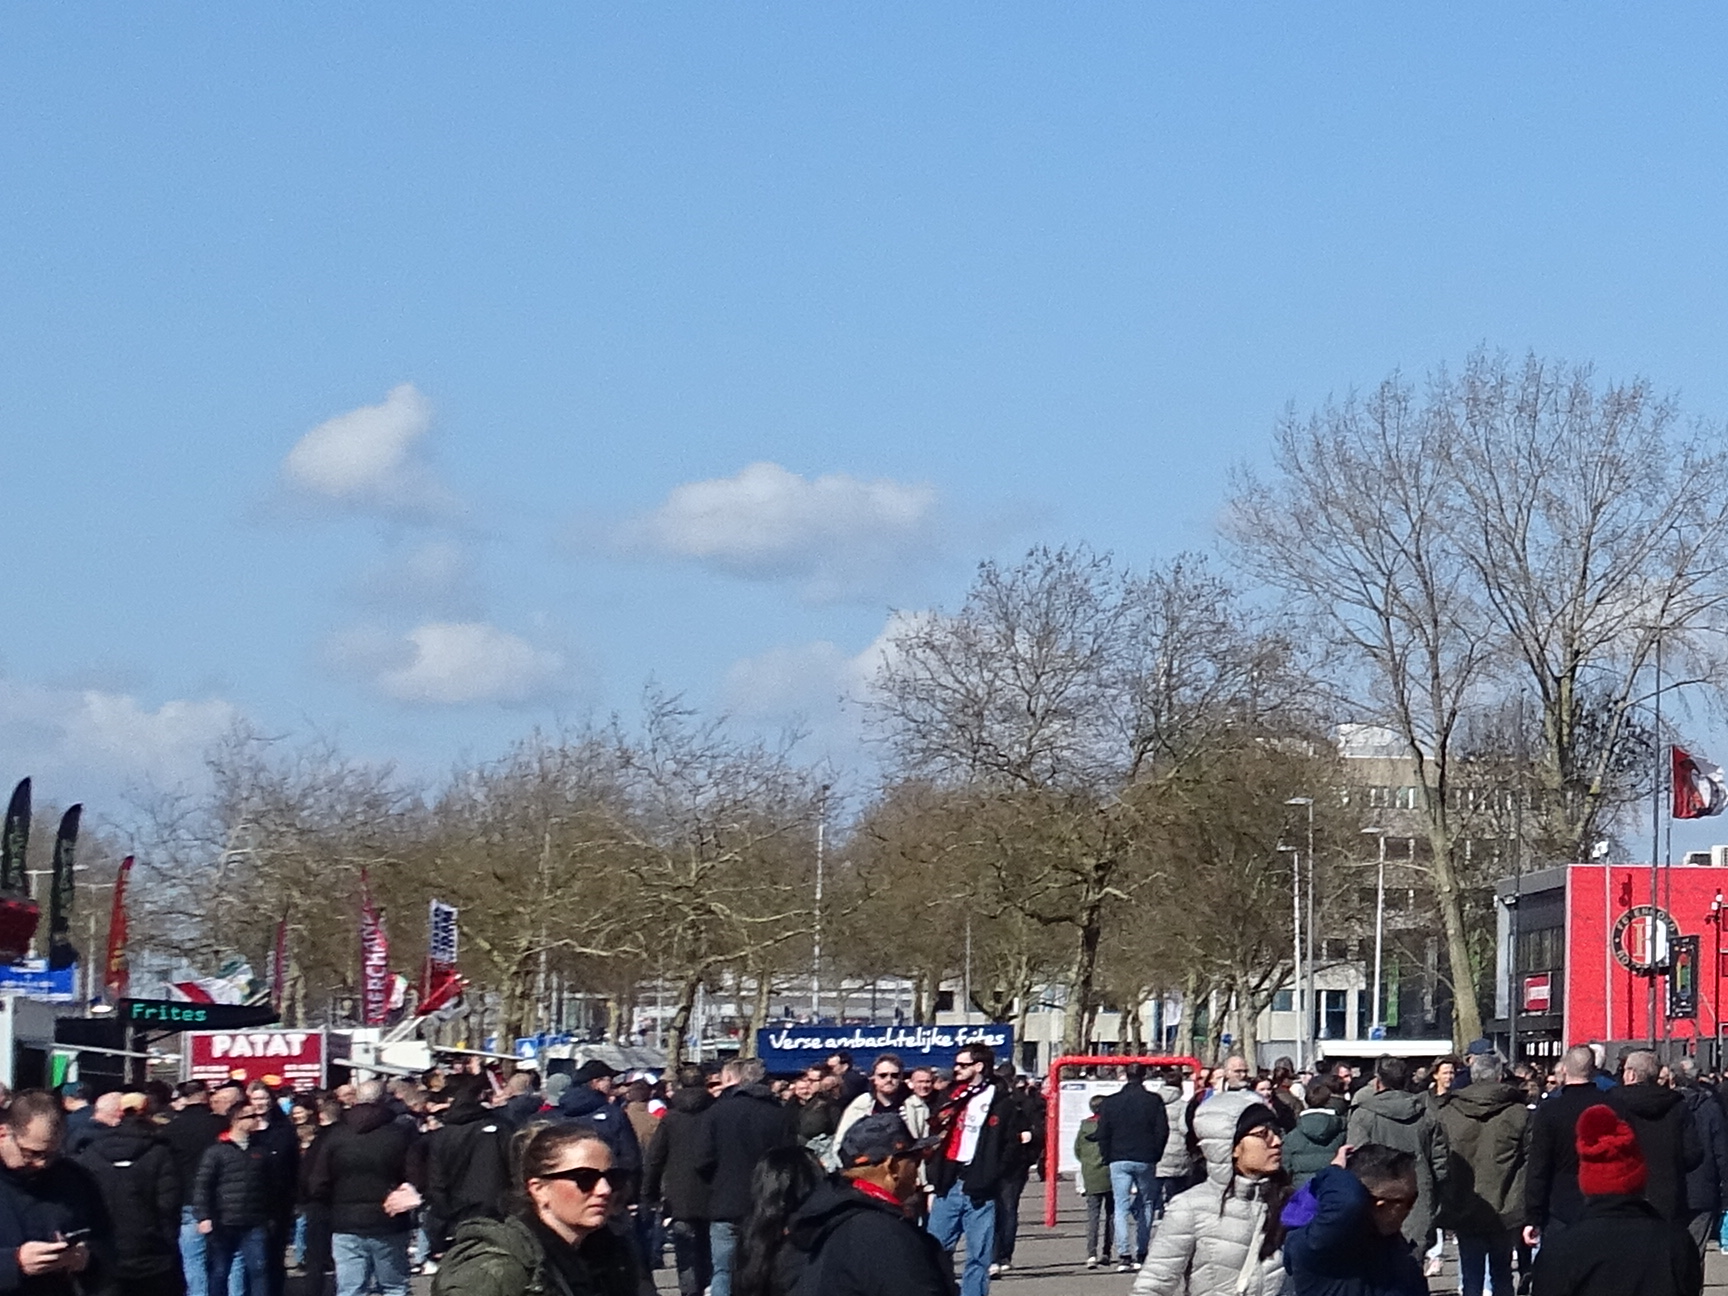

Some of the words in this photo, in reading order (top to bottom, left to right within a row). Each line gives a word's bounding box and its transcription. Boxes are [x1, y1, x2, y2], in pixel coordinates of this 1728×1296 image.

[132, 1003, 207, 1022] Frites
[211, 1034, 307, 1058] PATAT
[770, 1030, 823, 1050] Verse
[824, 1027, 951, 1053] ambachtelijke
[954, 1027, 1006, 1046] frites
